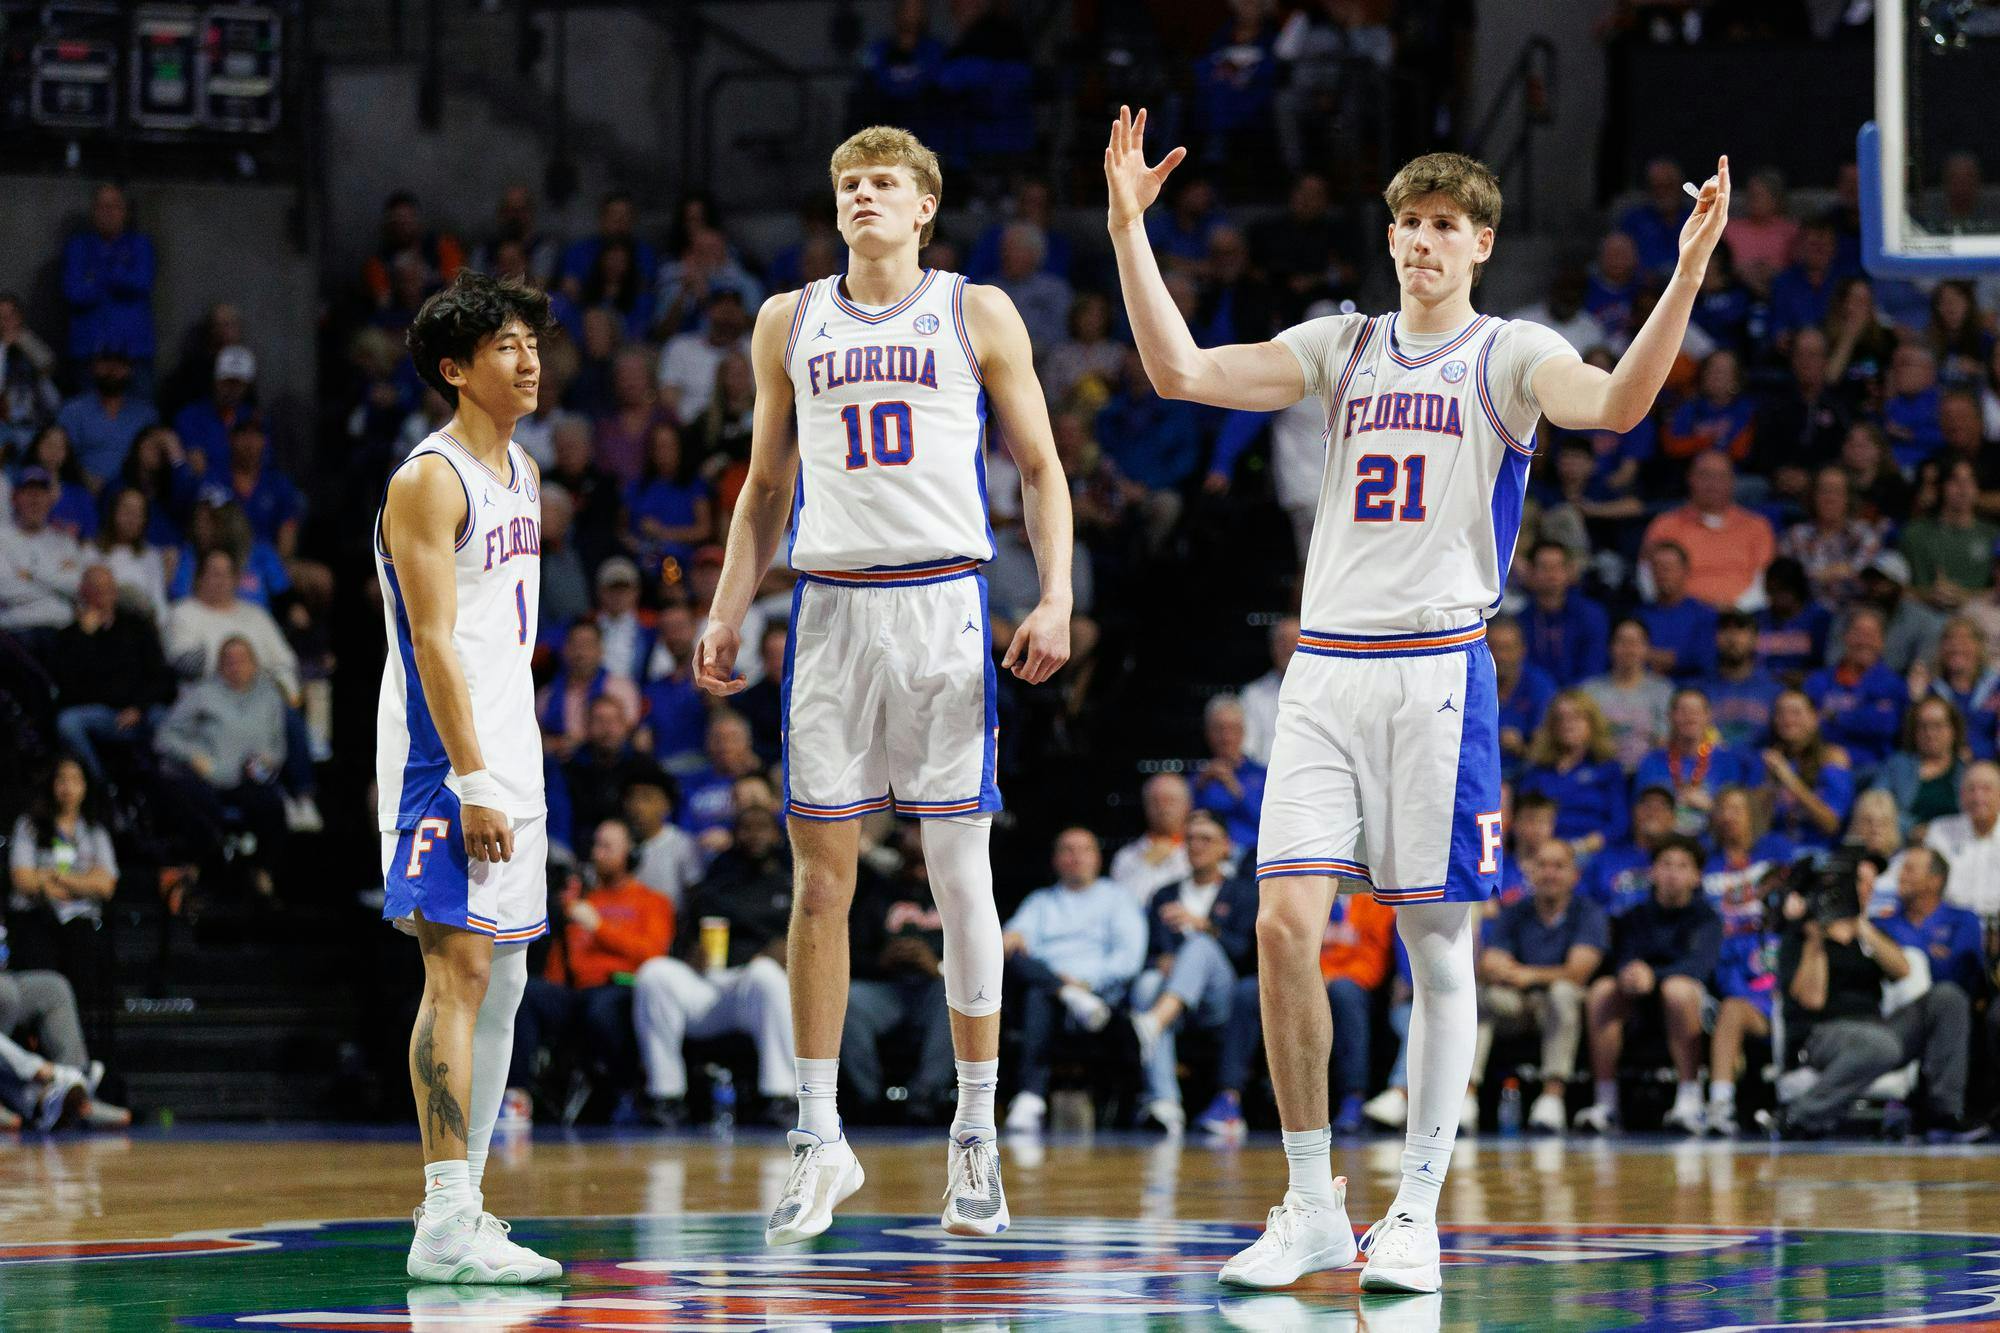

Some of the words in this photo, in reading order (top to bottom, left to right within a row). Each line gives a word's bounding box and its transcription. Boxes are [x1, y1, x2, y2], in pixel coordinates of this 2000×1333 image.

[808, 346, 938, 396] FLORIDA
[841, 401, 914, 470] 10
[1345, 392, 1463, 439] FLORIDA
[1354, 454, 1426, 522] 21
[484, 516, 541, 572] FLRID
[516, 580, 527, 645] 1
[406, 817, 450, 877] F
[1476, 808, 1503, 875] F
